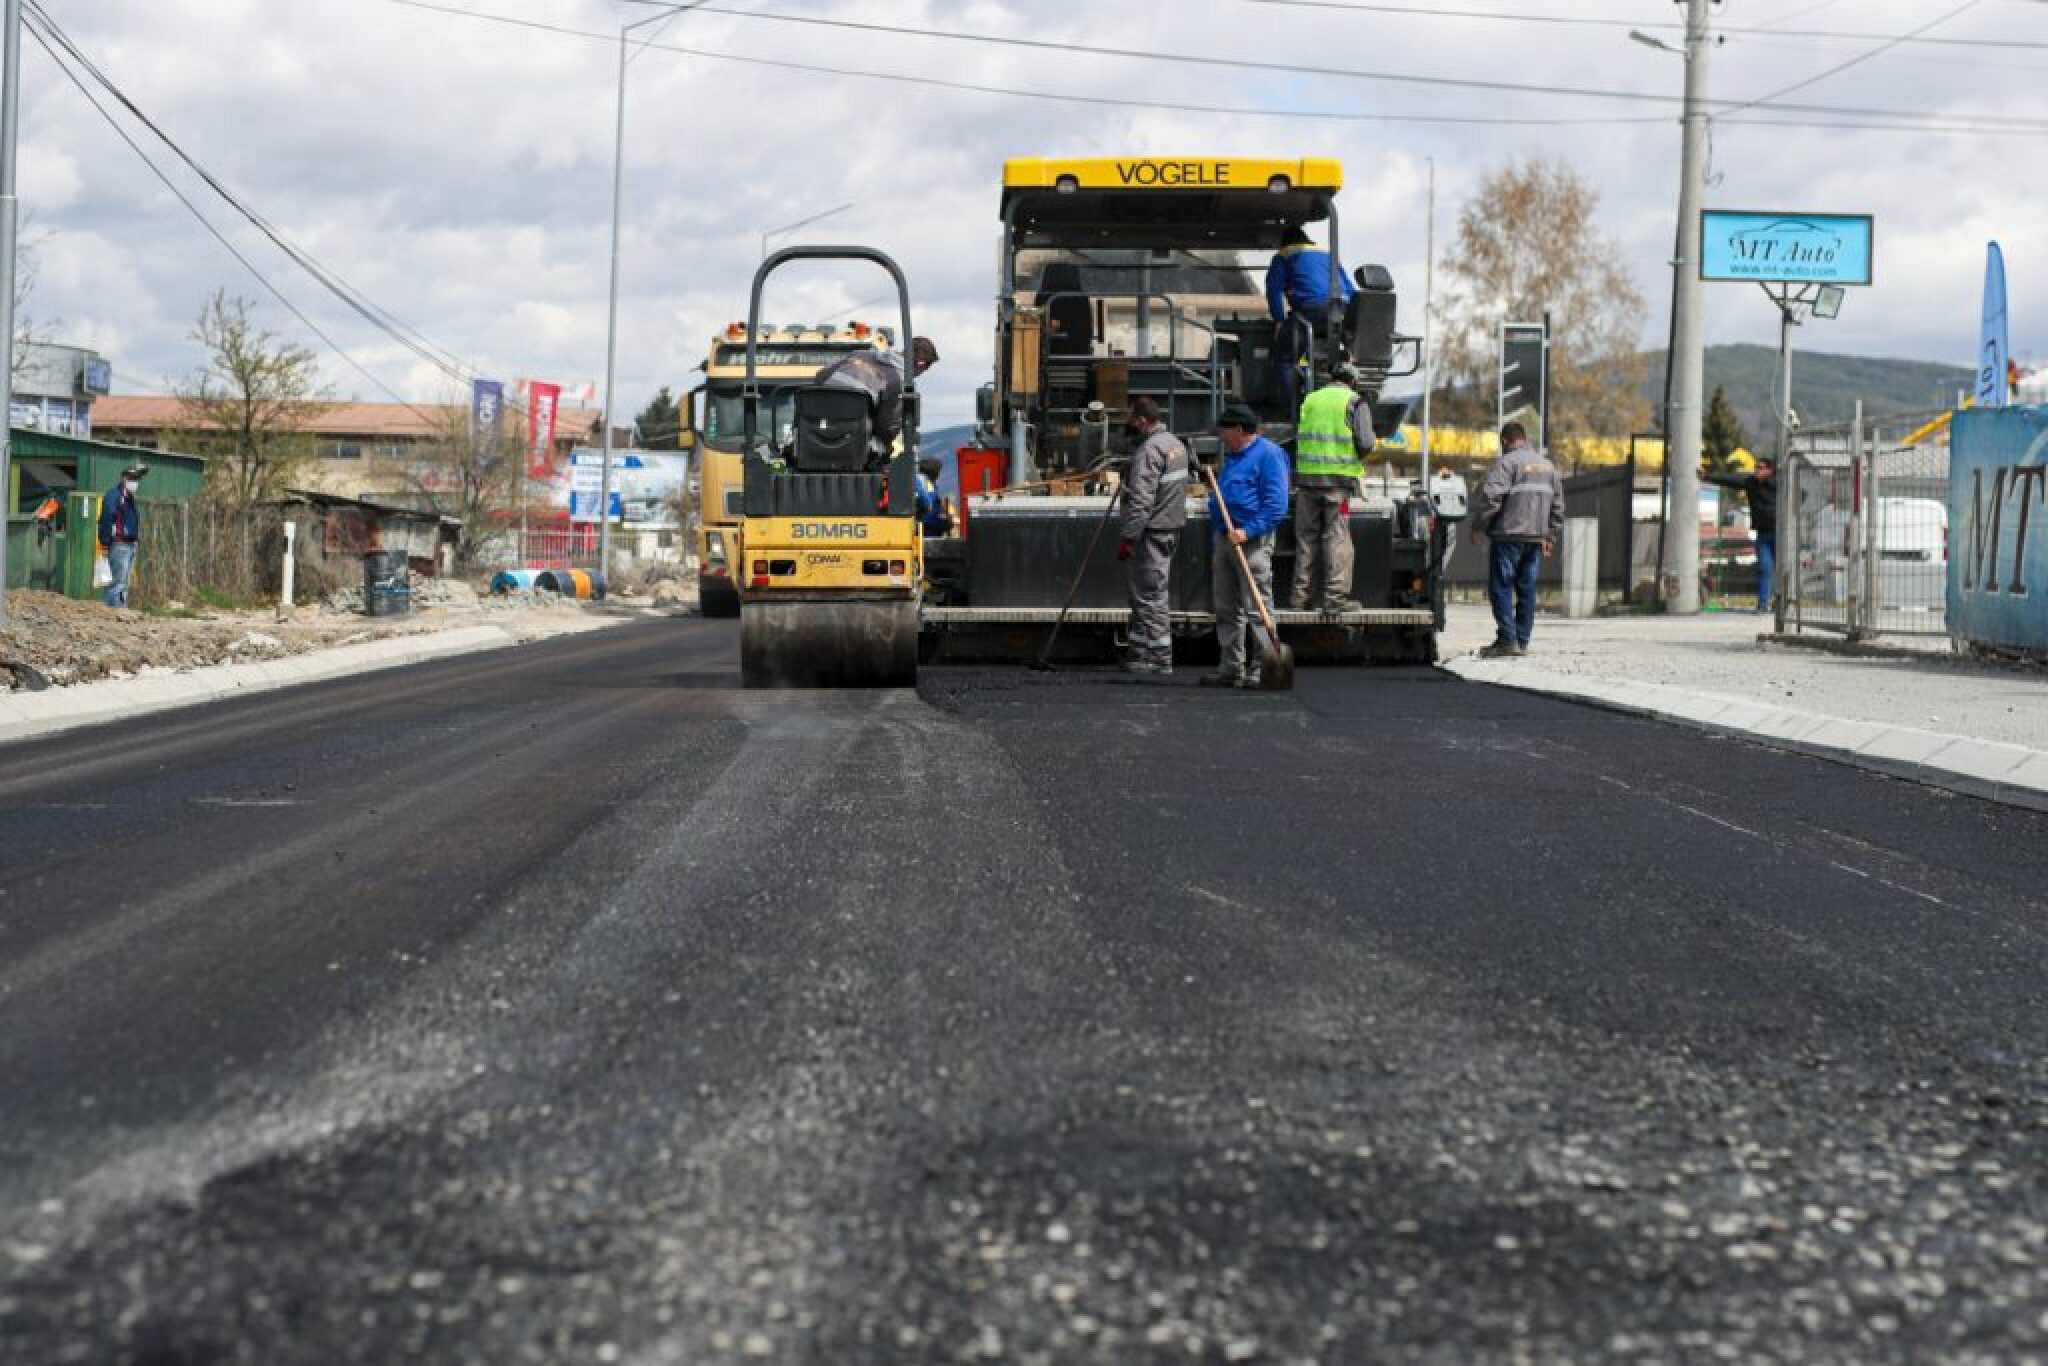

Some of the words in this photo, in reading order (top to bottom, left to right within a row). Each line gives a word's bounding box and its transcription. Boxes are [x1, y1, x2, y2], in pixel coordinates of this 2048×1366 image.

[1116, 160, 1231, 185] VÖGELE
[1733, 239, 1780, 262] MT
[1780, 240, 1836, 263] Auto
[791, 523, 868, 539] BOMAG
[1963, 465, 2047, 595] MT
